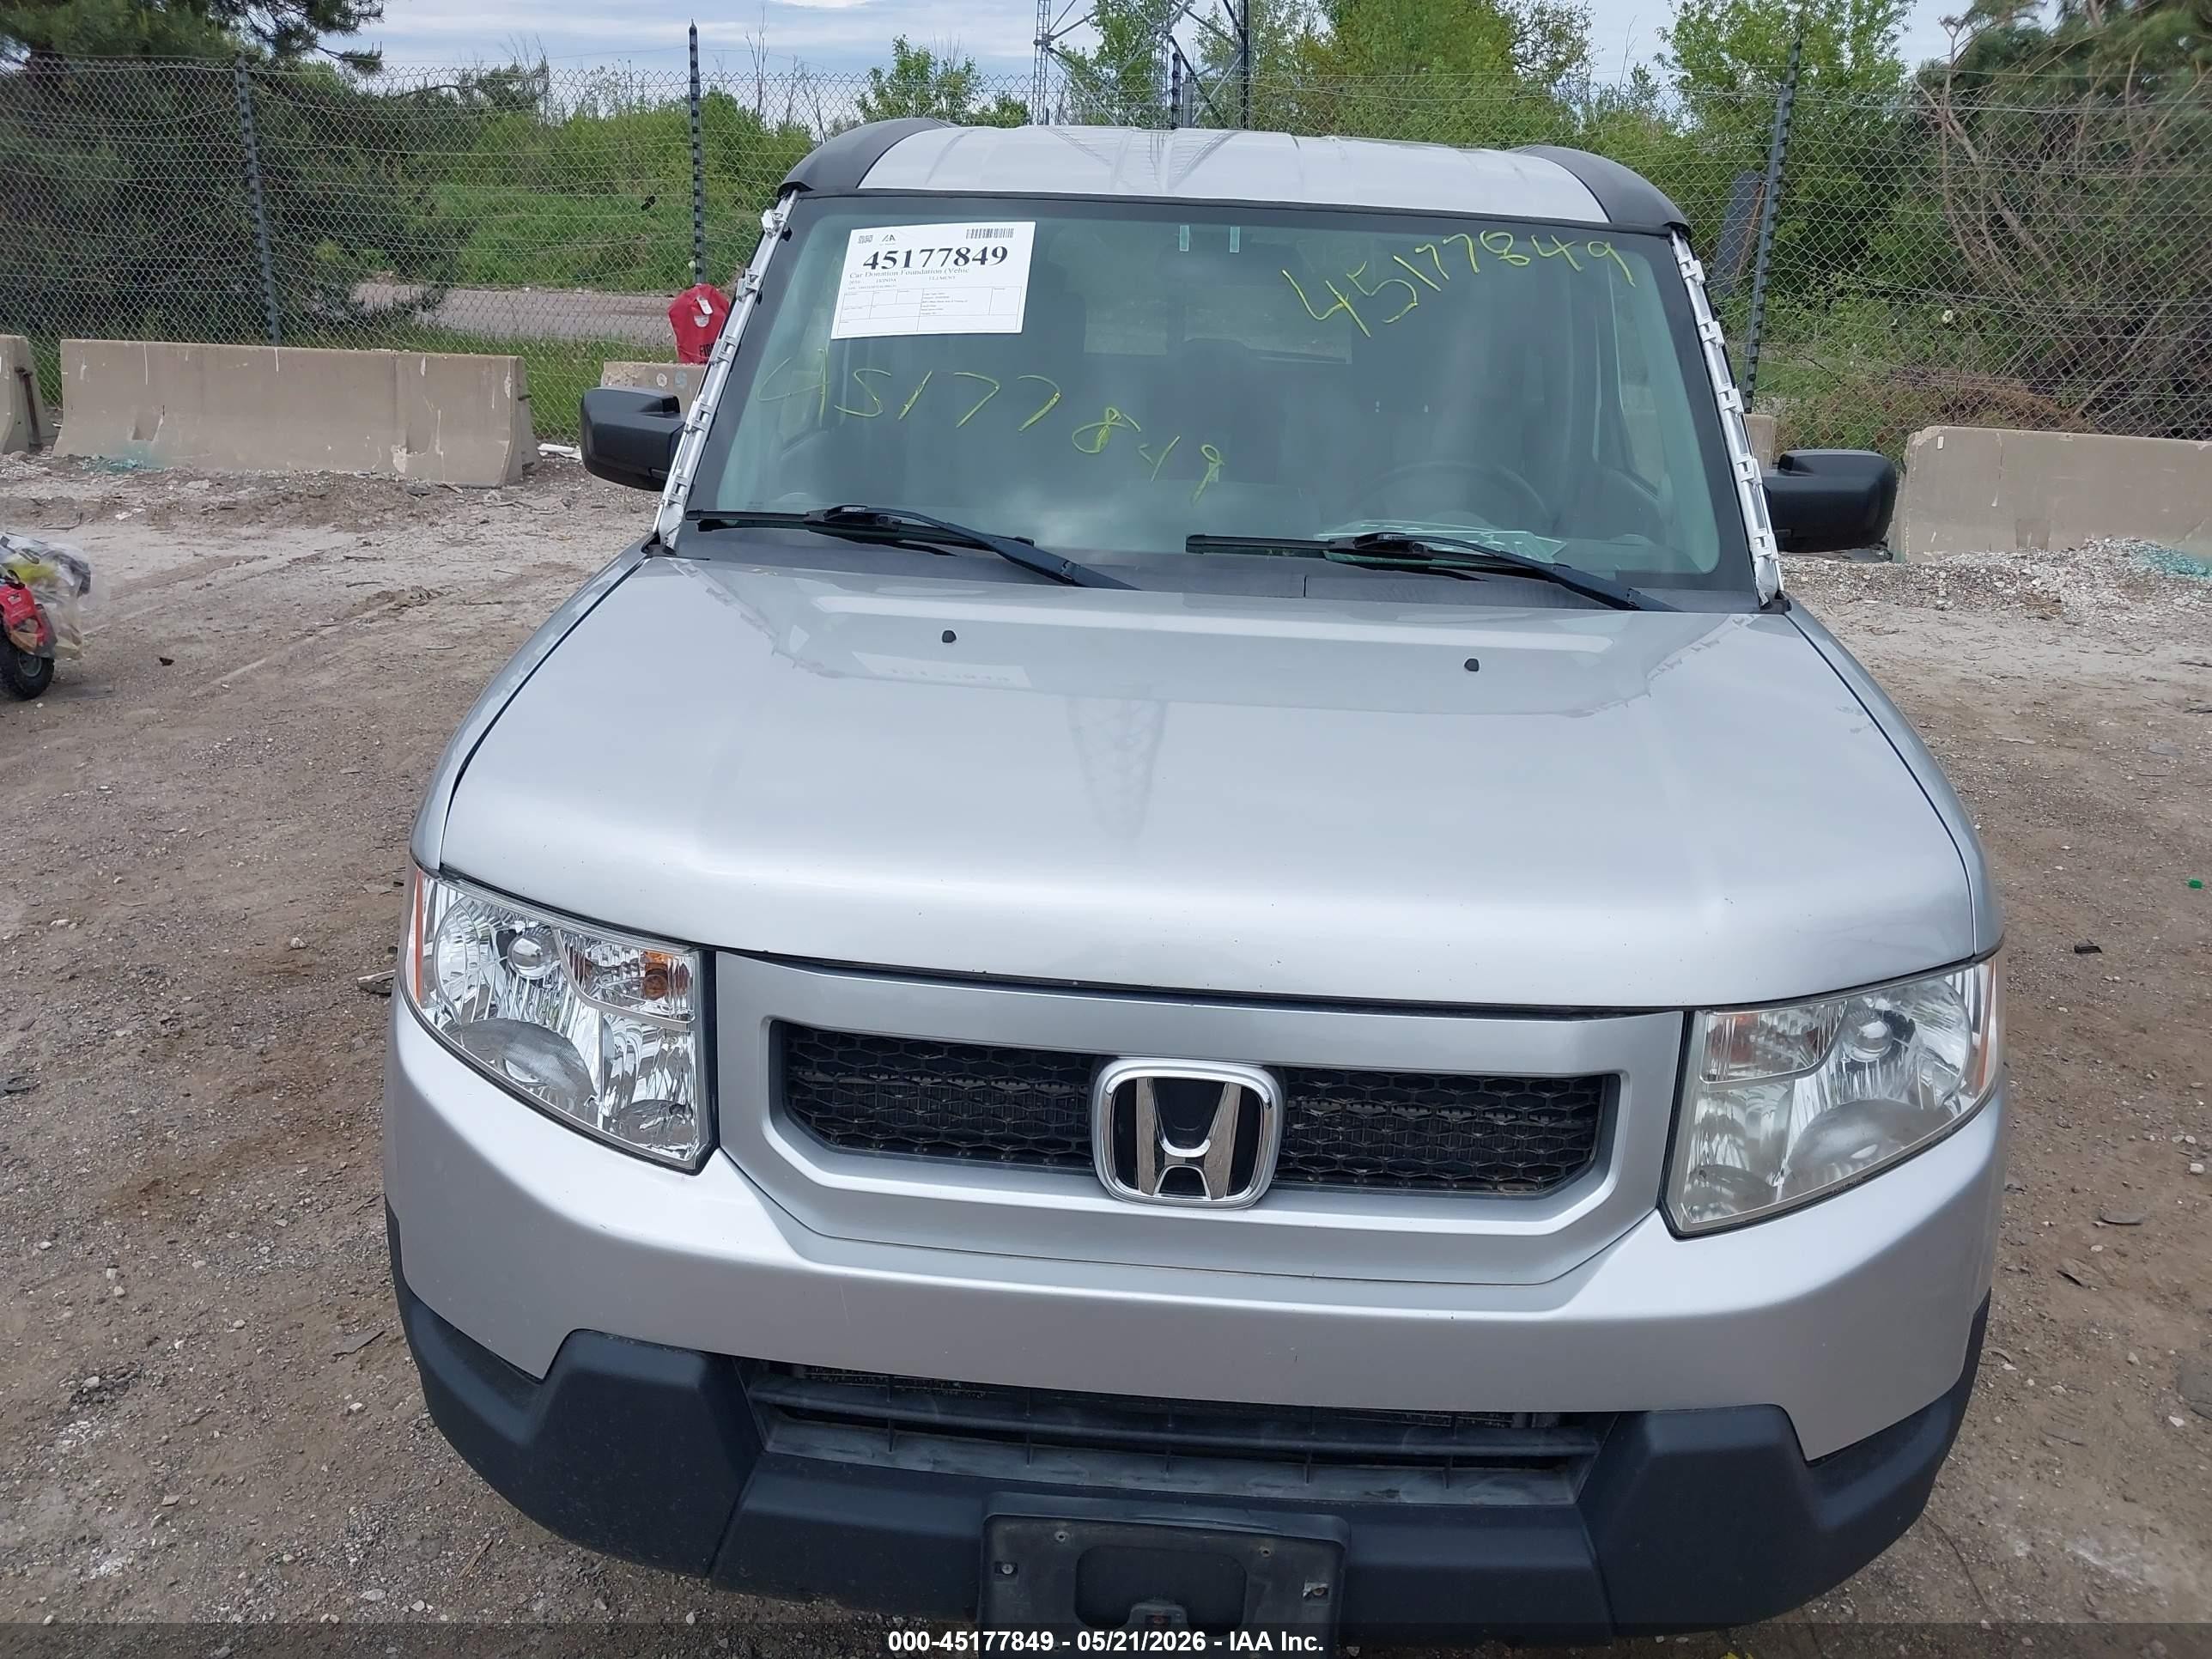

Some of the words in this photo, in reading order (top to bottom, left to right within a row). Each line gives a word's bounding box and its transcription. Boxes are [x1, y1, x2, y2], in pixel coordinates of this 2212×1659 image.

[863, 246, 1008, 270] 45177849
[1282, 229, 1636, 337] 45177849
[699, 343, 714, 357] FIR
